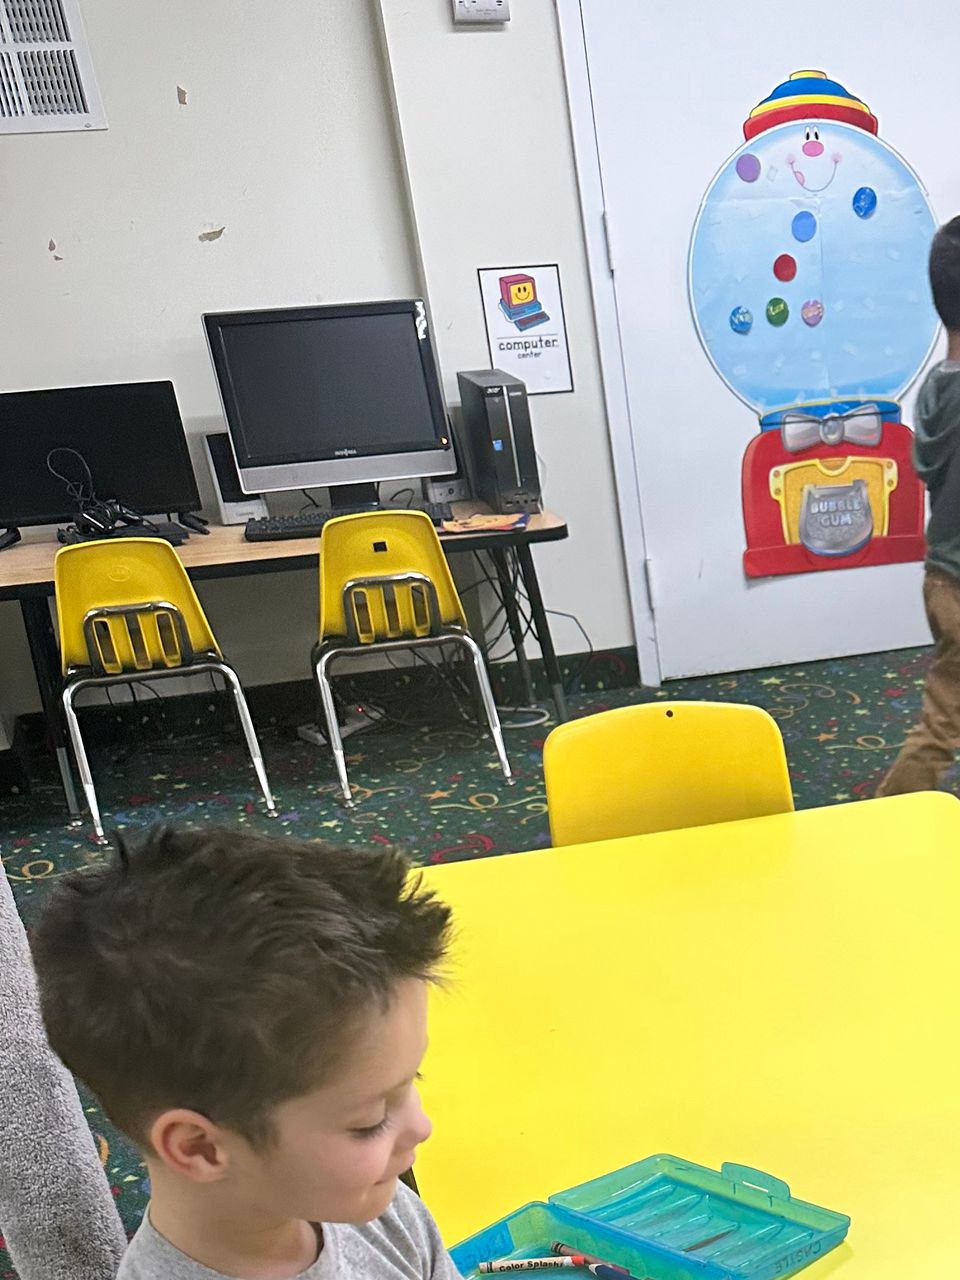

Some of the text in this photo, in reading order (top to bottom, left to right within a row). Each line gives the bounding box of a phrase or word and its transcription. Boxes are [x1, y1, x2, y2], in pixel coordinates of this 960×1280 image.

[499, 336, 558, 351] computer
[517, 351, 542, 359] center
[810, 500, 861, 514] BUBBLE
[820, 513, 852, 527] GUM
[499, 1262, 525, 1272] Color
